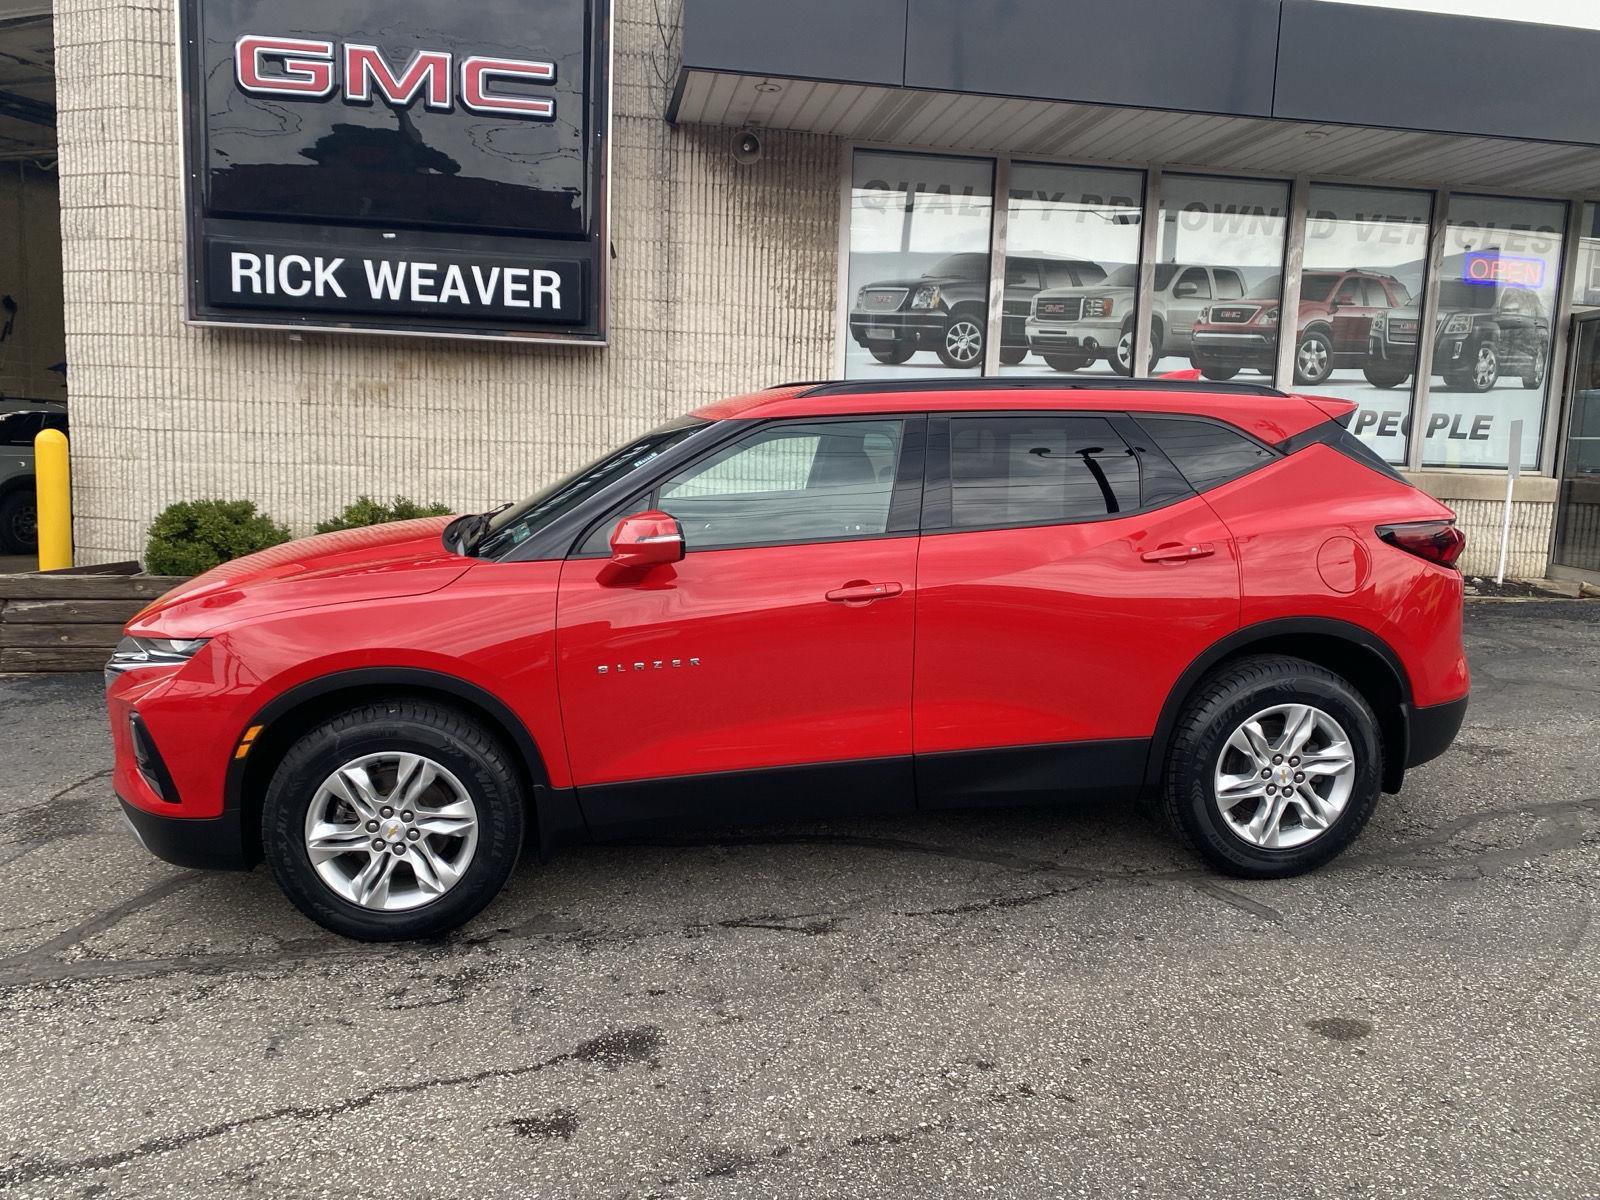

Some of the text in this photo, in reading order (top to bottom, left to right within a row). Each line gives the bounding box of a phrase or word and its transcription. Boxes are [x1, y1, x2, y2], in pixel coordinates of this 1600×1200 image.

[235, 35, 557, 119] GMC
[861, 179, 1066, 222] QUALTY
[1354, 212, 1556, 254] VEHCLES
[230, 252, 562, 310] RICK WEAVER
[1469, 258, 1542, 284] OPEN
[597, 657, 701, 674] BLAZER
